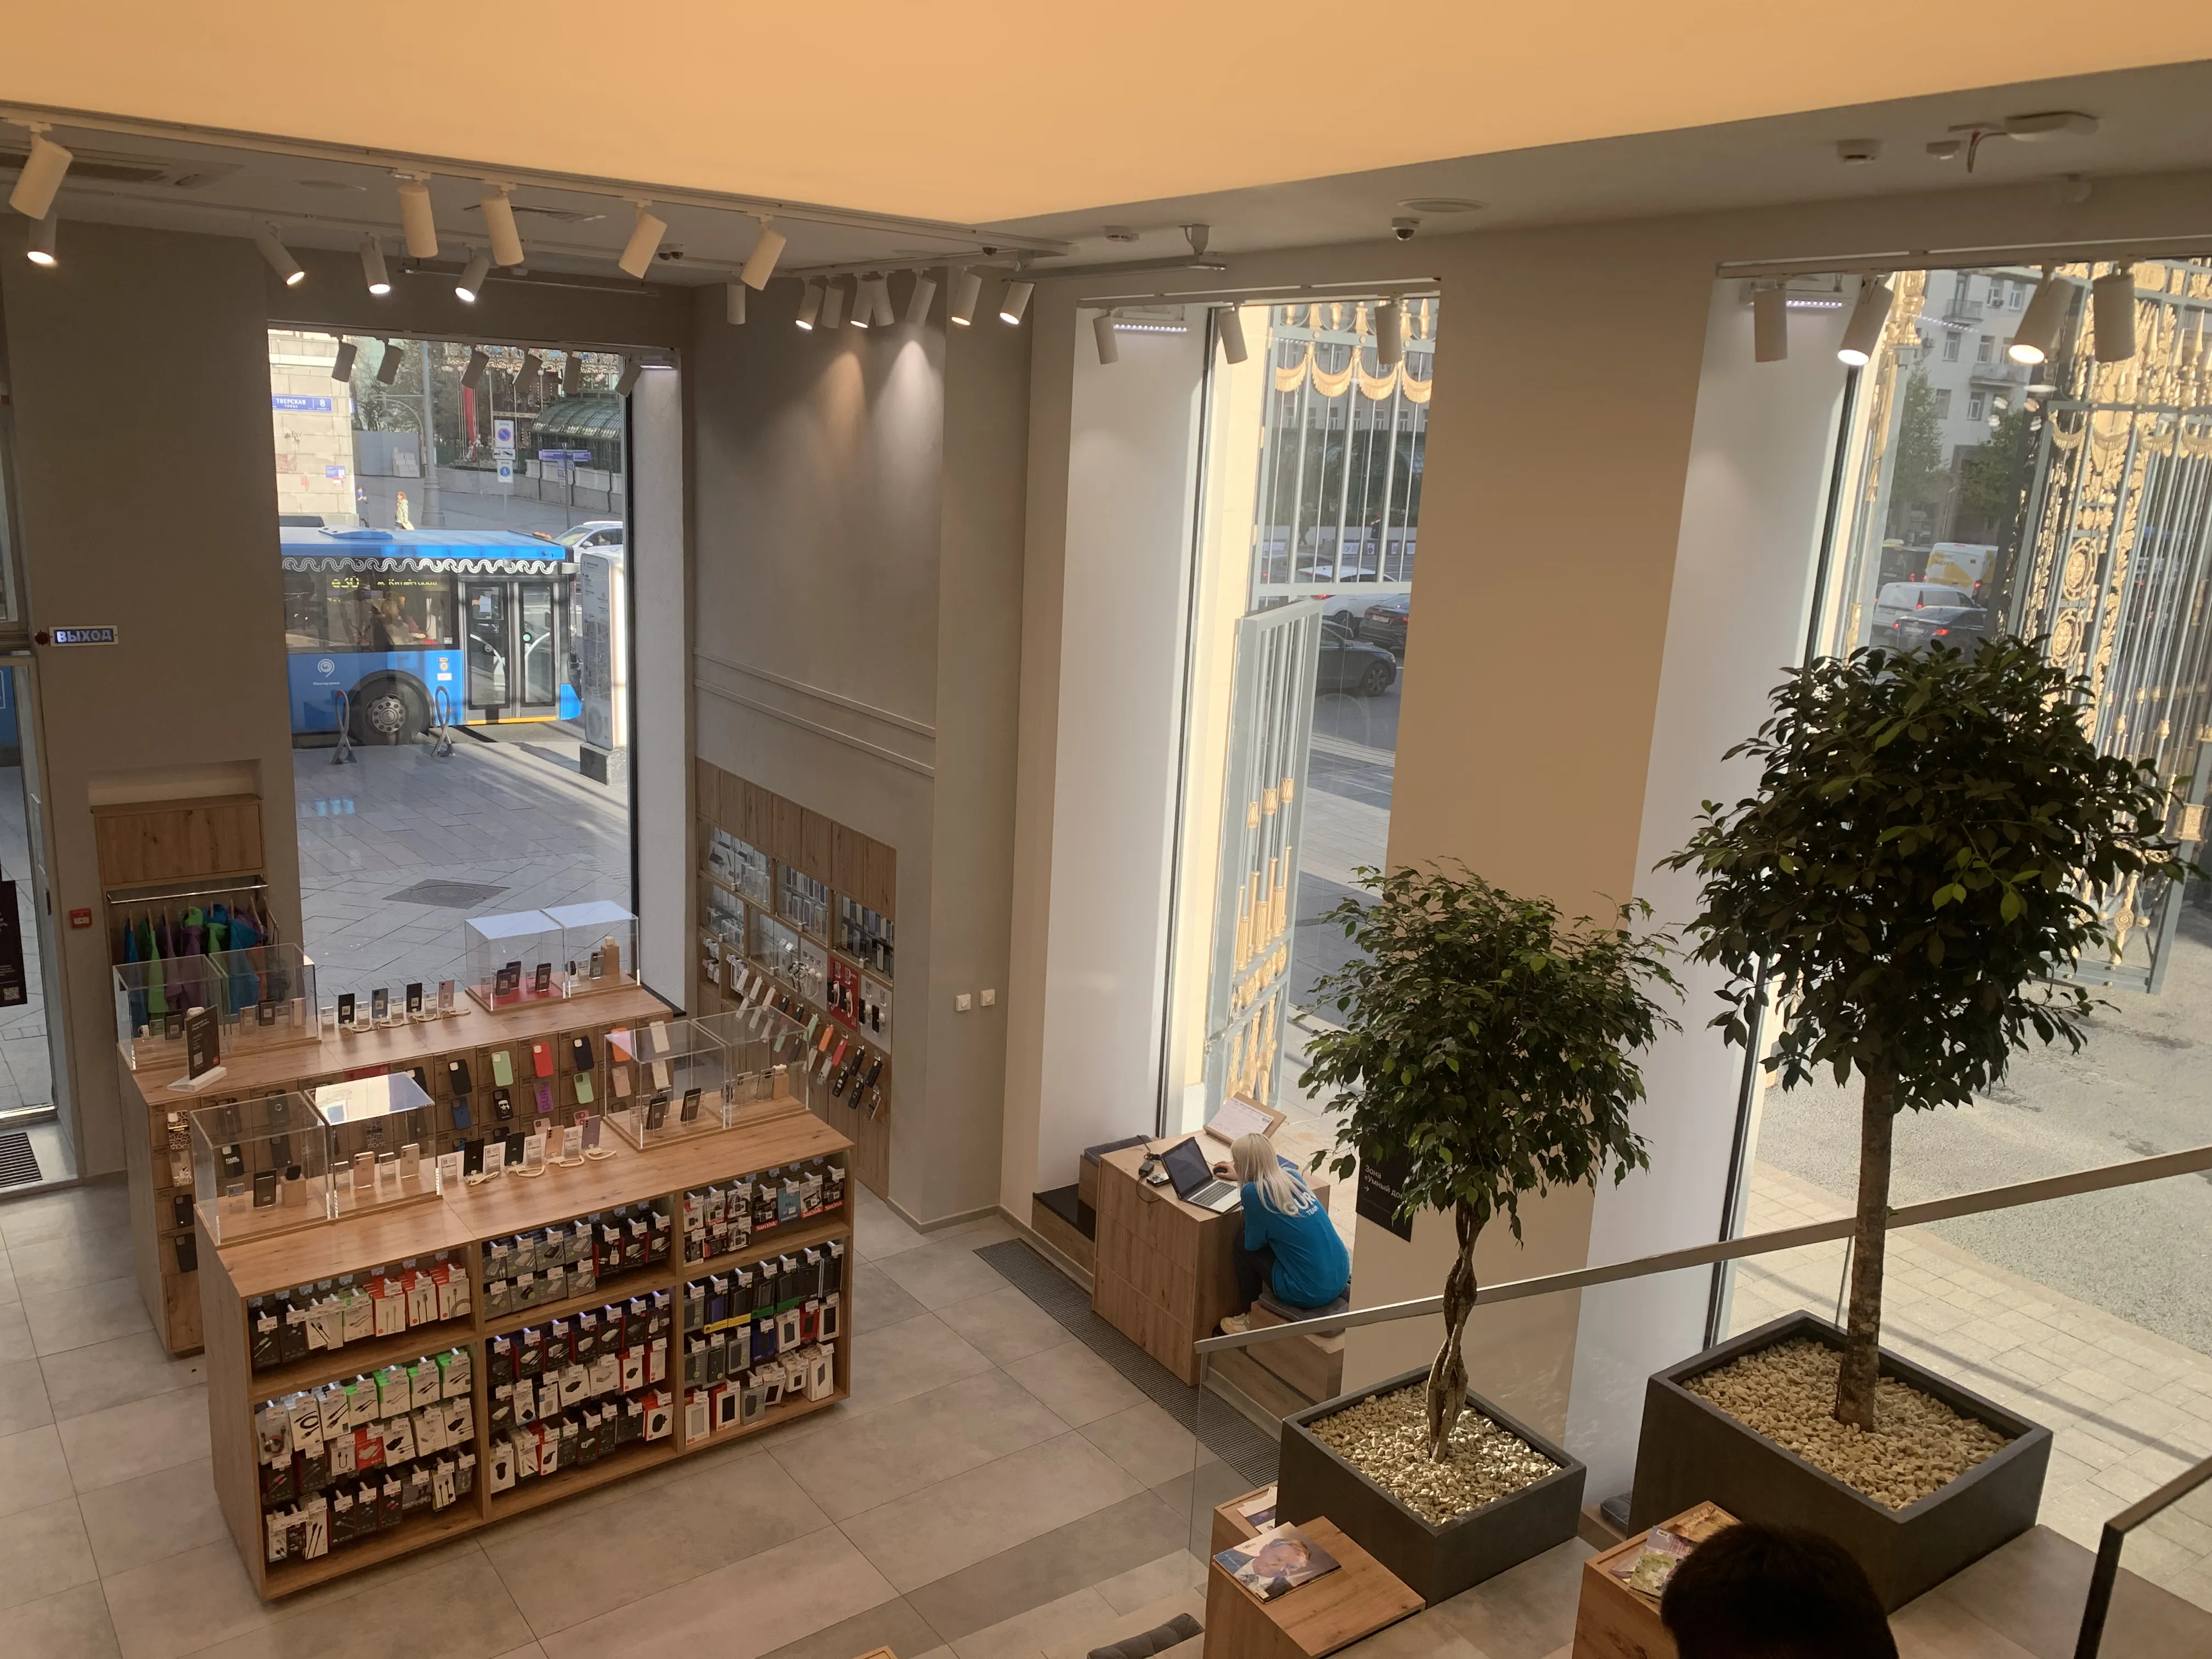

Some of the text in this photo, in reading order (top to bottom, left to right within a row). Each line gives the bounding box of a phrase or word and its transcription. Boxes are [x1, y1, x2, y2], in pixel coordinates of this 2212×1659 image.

[320, 399, 325, 407] 8
[57, 629, 112, 642] ВЫХОД
[1365, 1165, 1381, 1179] Зона
[1364, 1175, 1402, 1200] «Умный до
[1283, 1190, 1317, 1216] GUR
[803, 1208, 821, 1218] SanDisk
[757, 1221, 776, 1231] SanDisk
